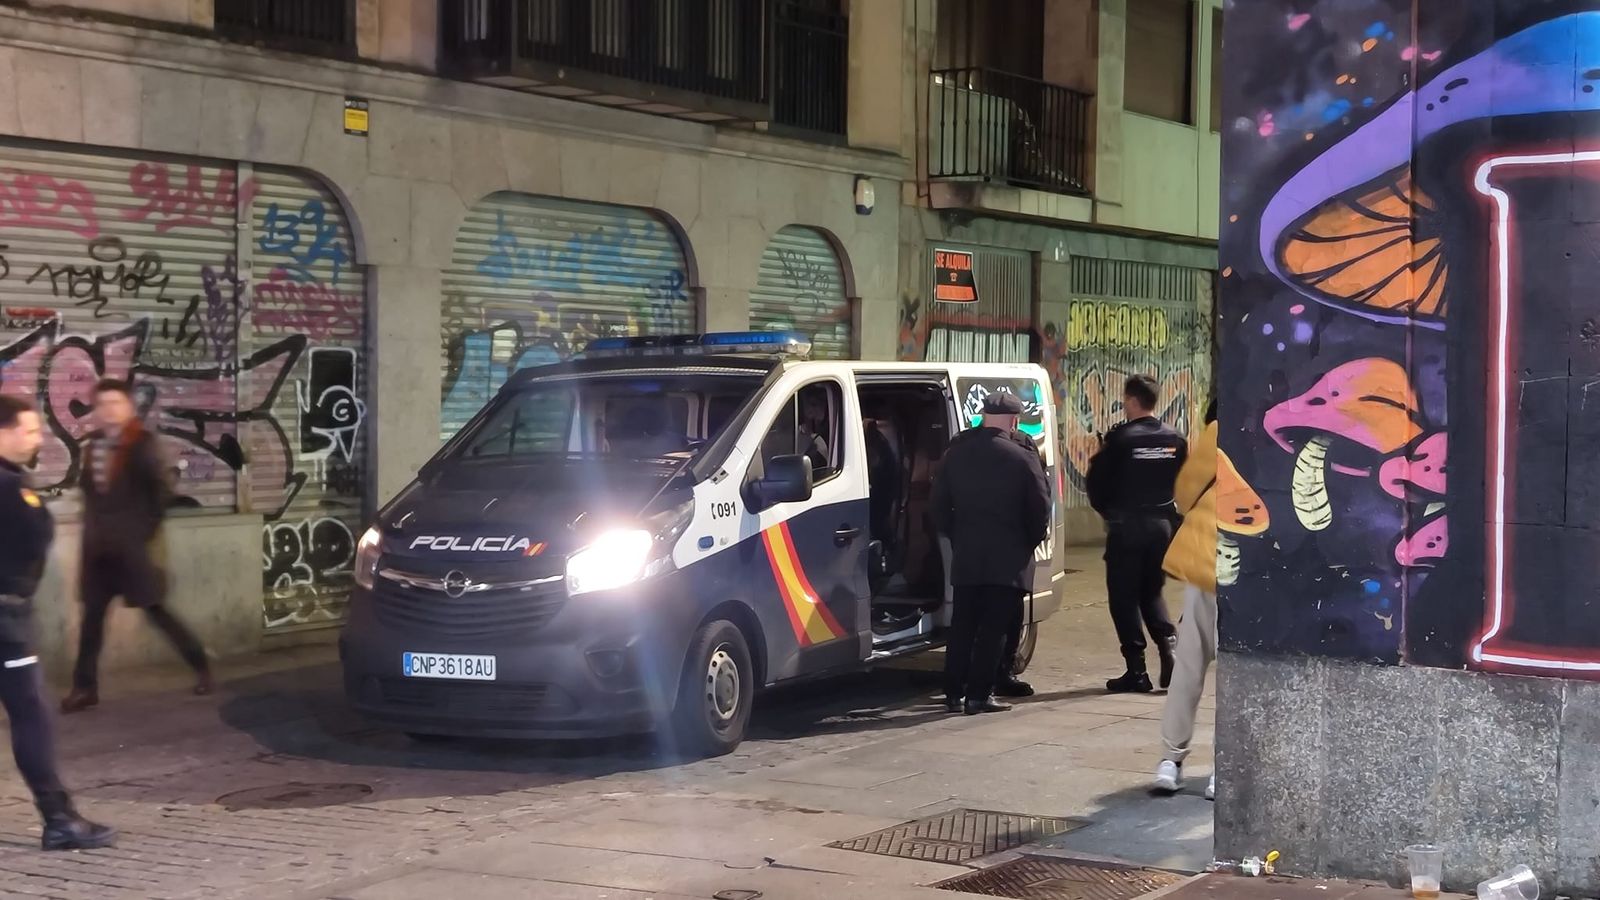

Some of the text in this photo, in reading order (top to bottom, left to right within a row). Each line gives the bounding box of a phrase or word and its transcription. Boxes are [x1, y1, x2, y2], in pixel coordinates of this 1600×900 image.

[936, 252, 971, 271] SE ALQUILA
[717, 501, 737, 518] 091
[409, 534, 530, 551] POLICÍA
[411, 656, 493, 676] CNP3618AU
